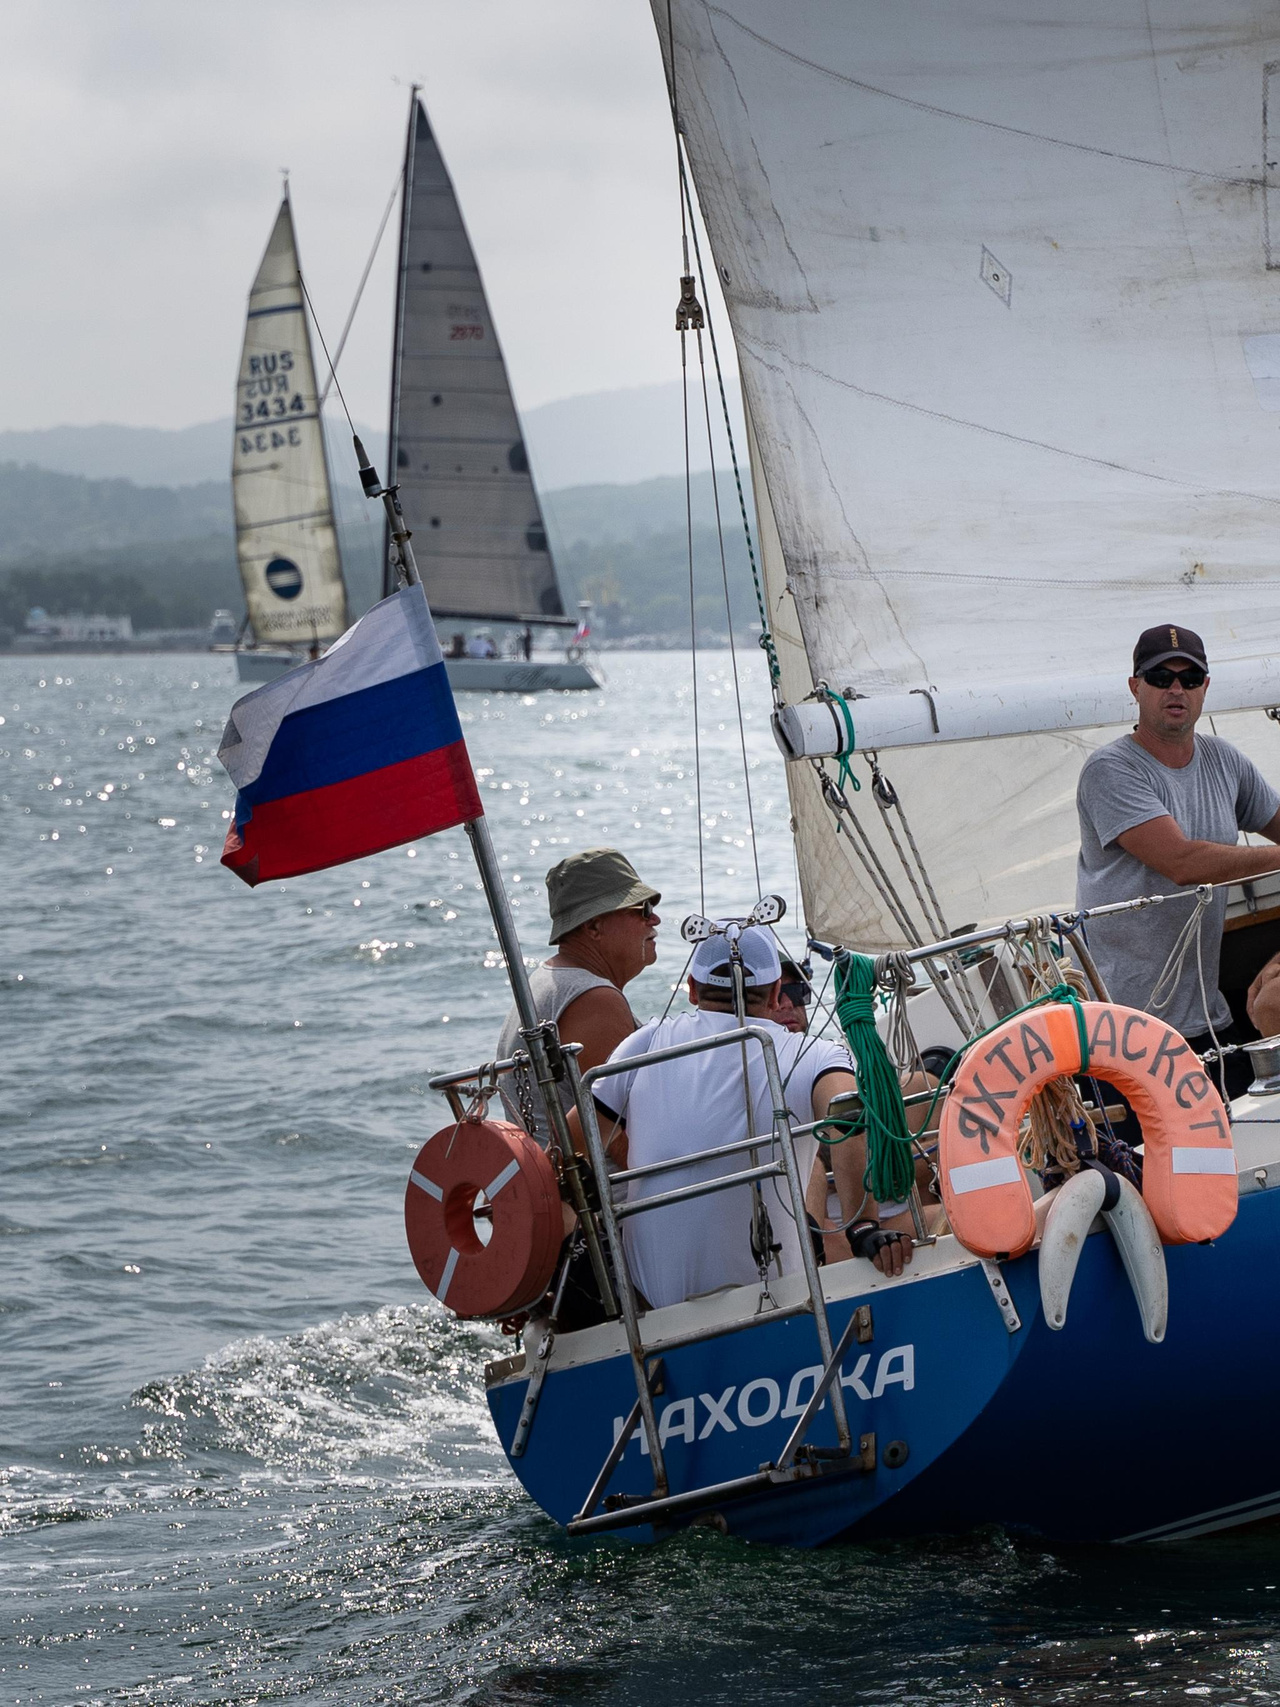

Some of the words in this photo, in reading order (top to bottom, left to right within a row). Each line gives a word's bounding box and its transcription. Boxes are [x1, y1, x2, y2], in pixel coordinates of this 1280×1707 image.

[248, 350, 294, 375] RUS
[241, 393, 305, 423] 3434
[957, 1022, 1054, 1155] ЯХТА
[613, 1344, 915, 1462] НАХОДКА
